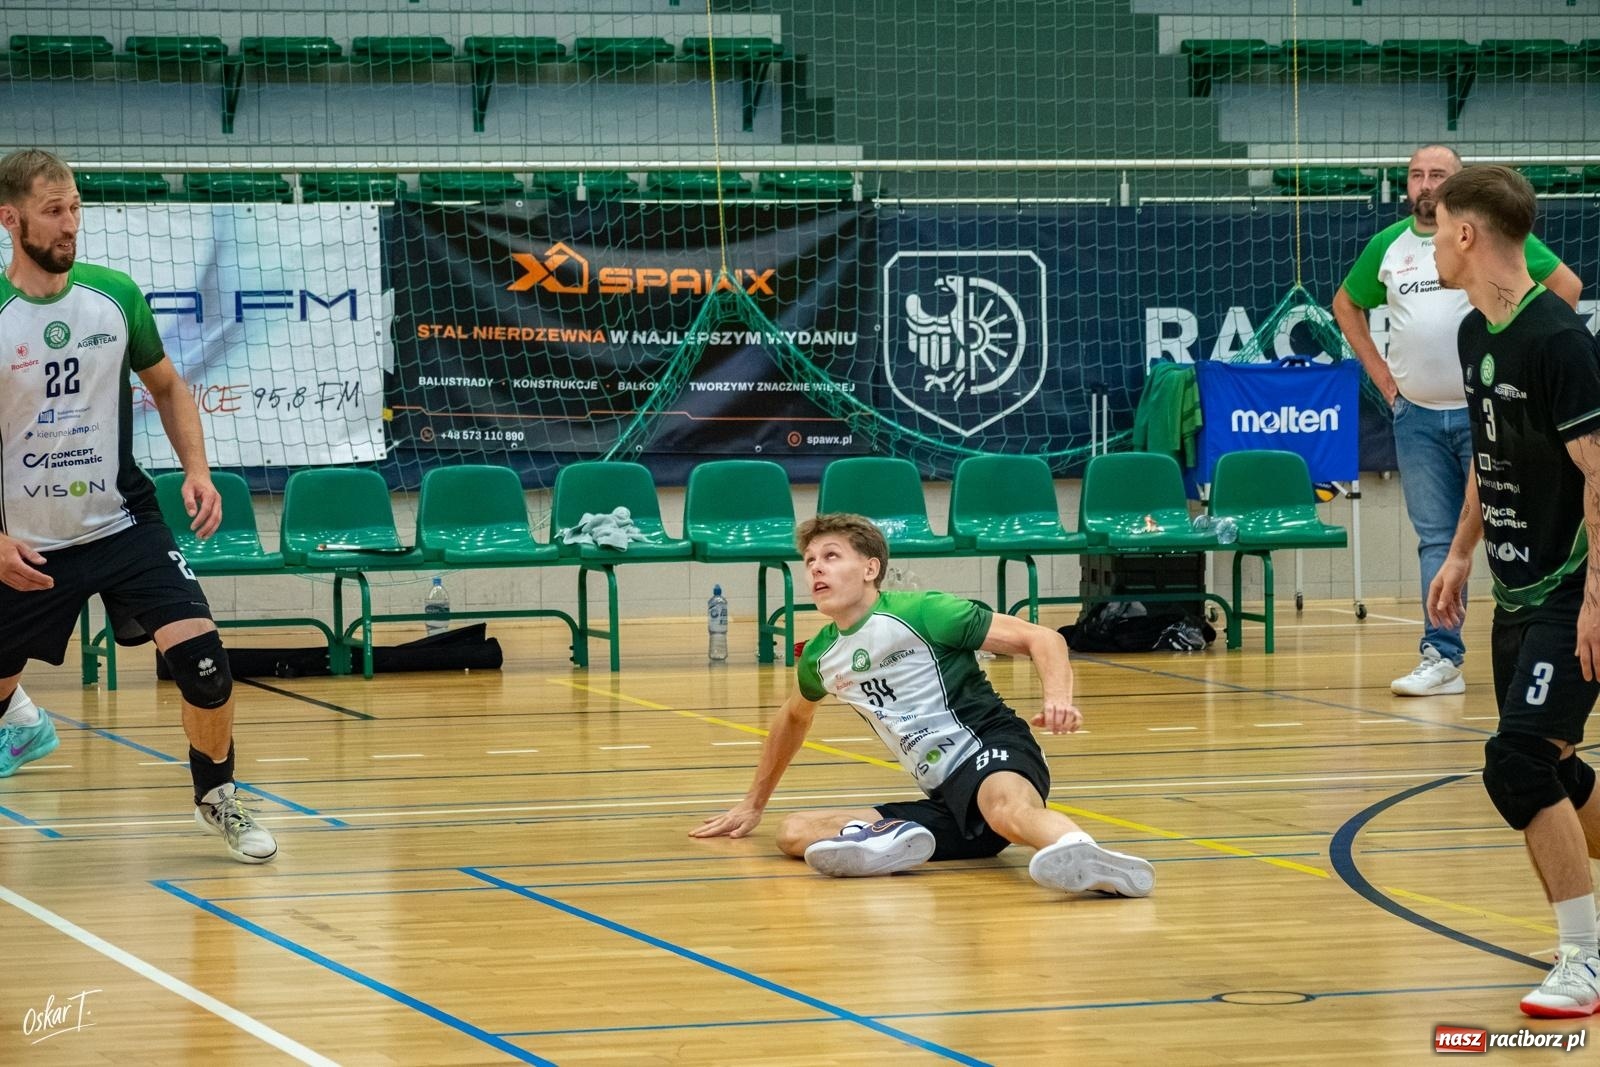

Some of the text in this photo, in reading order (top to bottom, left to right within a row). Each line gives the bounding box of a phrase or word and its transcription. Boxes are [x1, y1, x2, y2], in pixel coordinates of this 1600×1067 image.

[599, 267, 777, 296] SPAWX
[235, 289, 357, 323] FM
[416, 324, 858, 346] STAL NIERDZEWNA W NAJLEPSZYM WYDANIU
[45, 357, 80, 398] 22
[418, 376, 494, 387] BALUSTRADY
[513, 379, 599, 390] KONSTRUKCJE
[689, 382, 755, 392] TWORZYMY
[756, 382, 811, 392] ZNACZNIE
[1230, 406, 1341, 435] molten
[1482, 398, 1497, 442] 3
[462, 430, 482, 441] 573
[484, 431, 503, 442] 110
[505, 431, 525, 442] 890
[806, 434, 853, 447] spawx.pl
[51, 447, 95, 460] CONCEPT
[51, 455, 103, 469] automatic
[24, 479, 106, 498] VISON
[1526, 661, 1554, 706] 3
[976, 748, 1010, 771] 54
